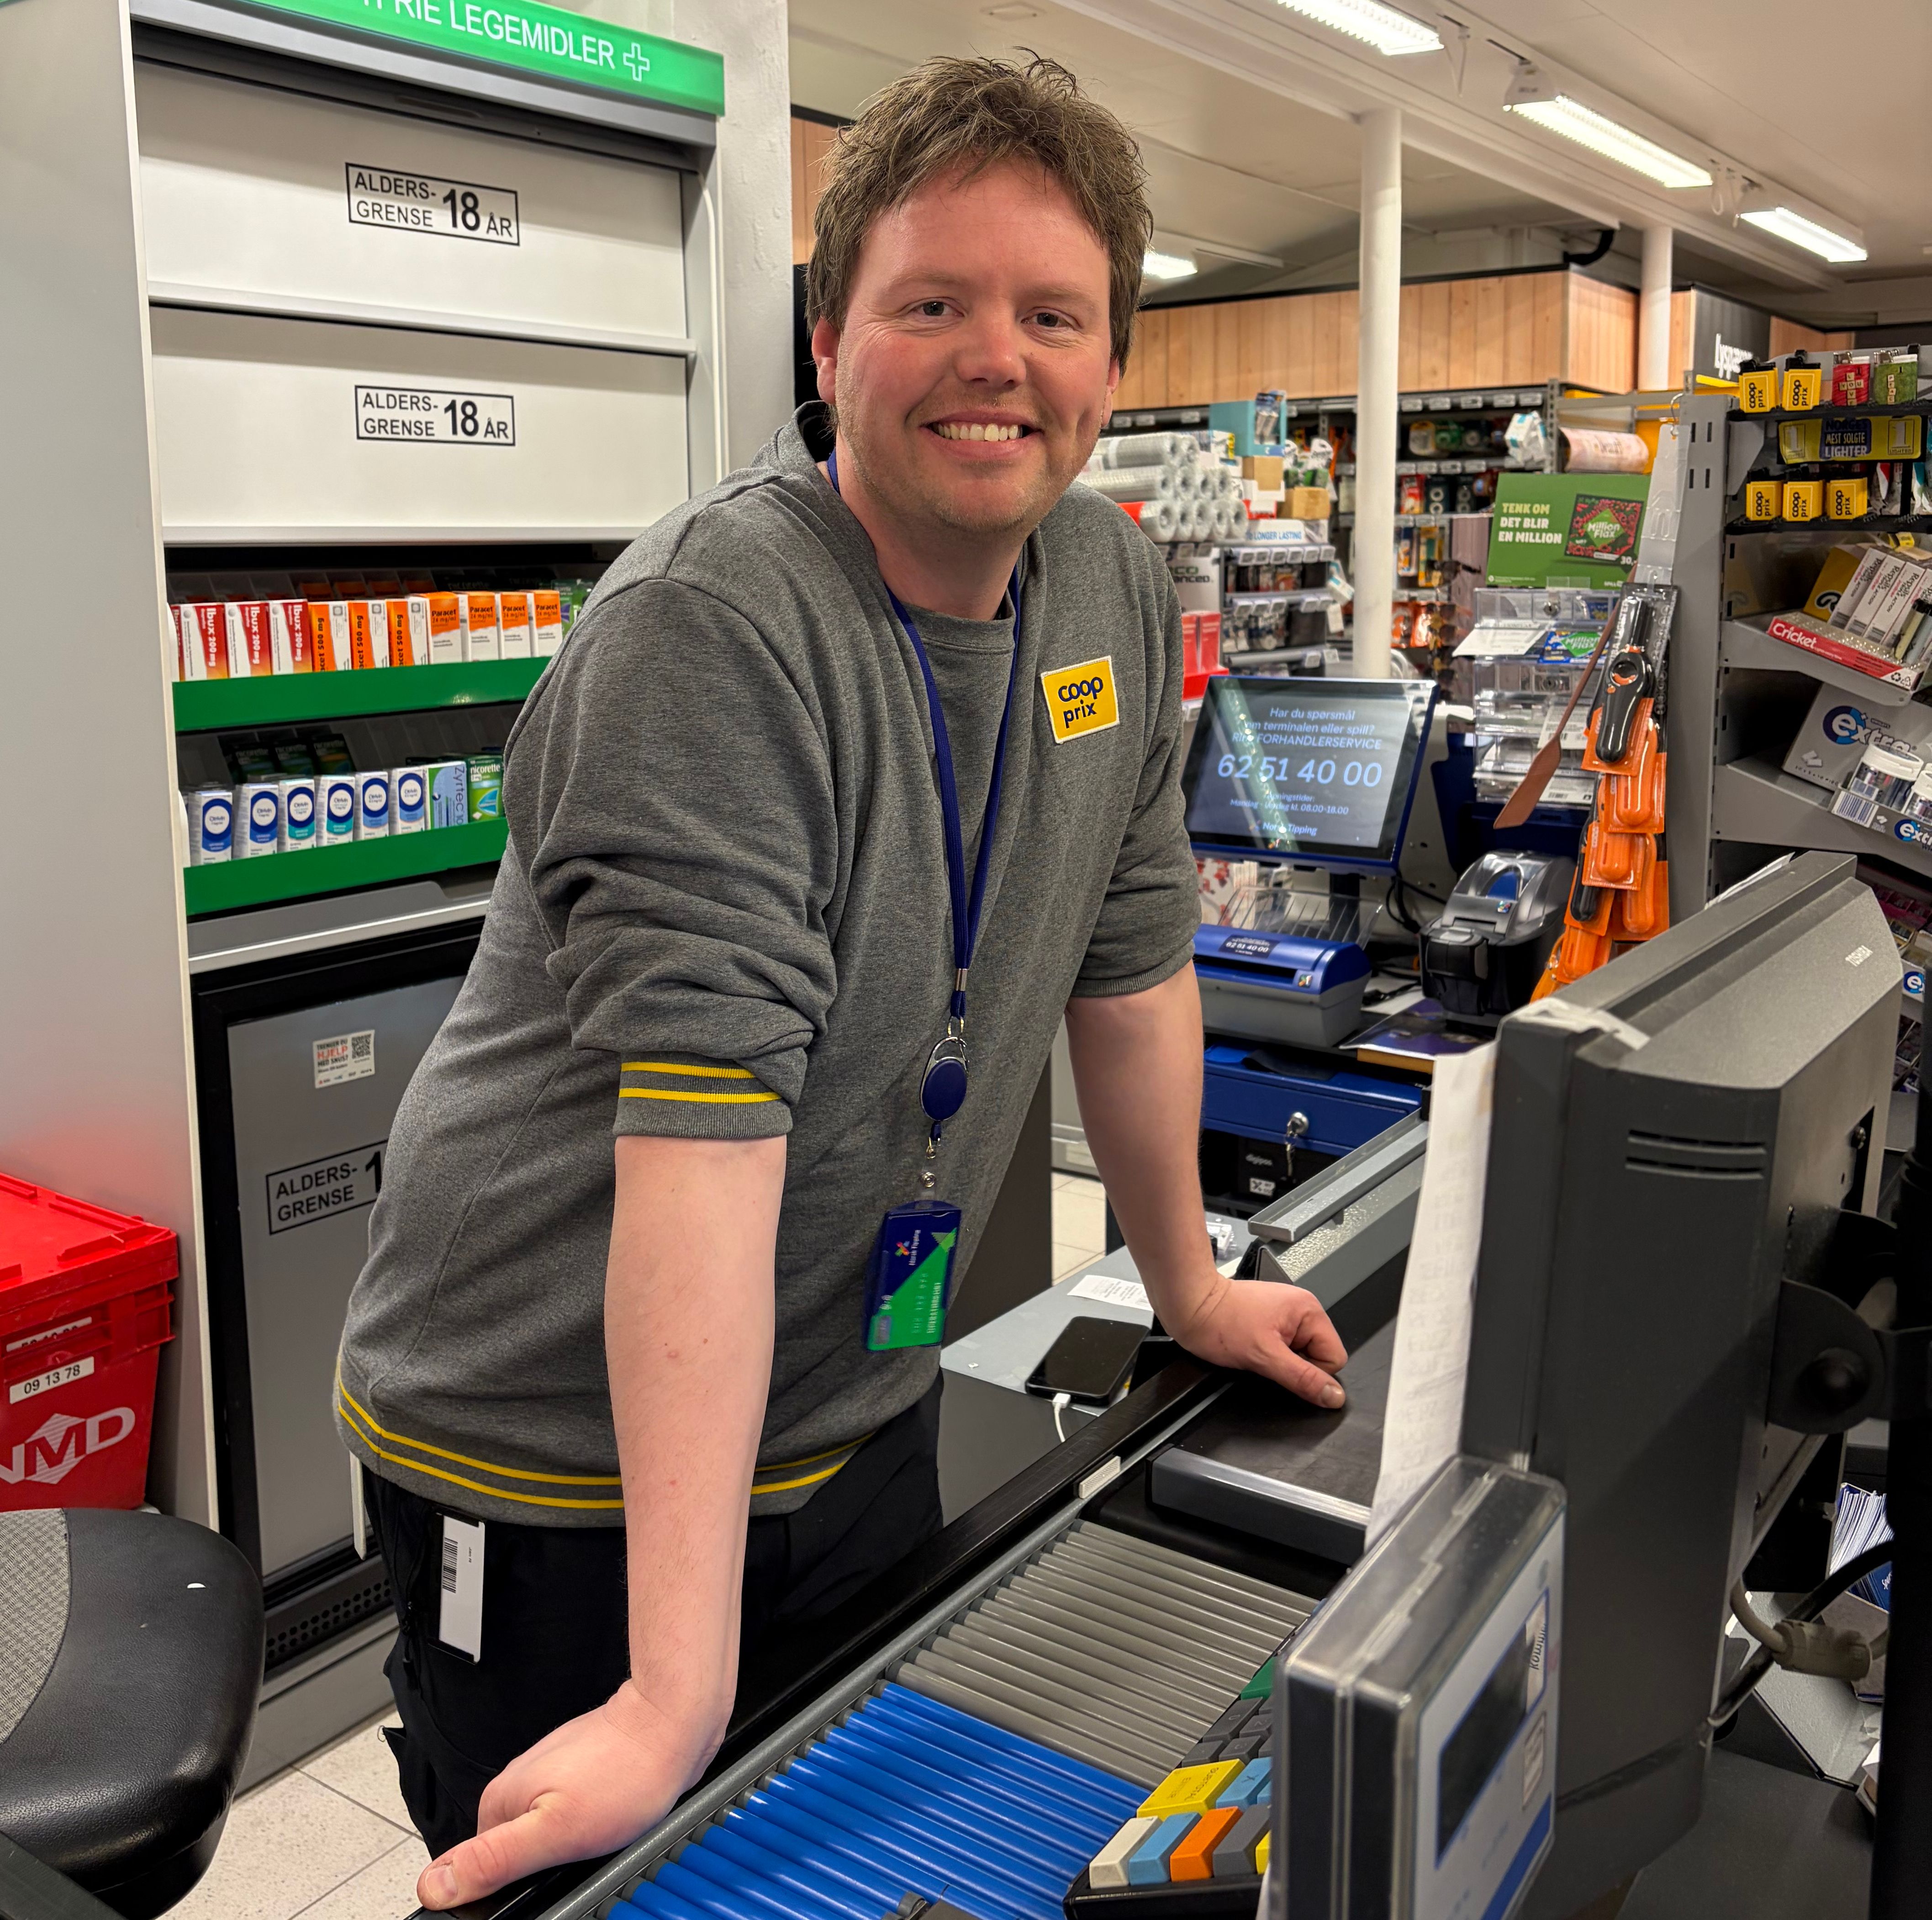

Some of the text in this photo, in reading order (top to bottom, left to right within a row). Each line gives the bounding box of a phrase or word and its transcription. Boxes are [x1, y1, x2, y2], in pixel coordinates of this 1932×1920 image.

[450, 0, 615, 69] LEGEMIDLER
[354, 172, 437, 200] ALDERS-
[356, 201, 434, 227] GRENSE
[442, 188, 514, 238] 18 ÅR
[363, 392, 438, 412] ALDERS-
[1749, 382, 1757, 408] coop
[1756, 390, 1765, 408] prix
[1792, 380, 1802, 406] coop
[1800, 387, 1808, 406] prix
[364, 418, 435, 436] GRENSE
[444, 399, 509, 439] 18 ÅR
[1827, 419, 1868, 430] NORGES
[1826, 433, 1865, 444] MEST SOLGTE
[1825, 445, 1868, 457] LIGHTER
[1502, 503, 1550, 514] TENK OM
[1756, 491, 1764, 517] coop
[1763, 498, 1771, 516] prix
[1792, 492, 1800, 518] coop
[1800, 499, 1808, 517] prix
[1836, 490, 1844, 516] coop
[1842, 497, 1852, 515] prix
[1500, 517, 1549, 529] DET BLIR
[1588, 522, 1620, 531] Million
[1254, 531, 1302, 540] LONGER LASTING
[1499, 531, 1513, 542] EN
[1515, 532, 1562, 544] MILLION
[318, 618, 324, 632] mg
[357, 615, 364, 629] mg
[396, 614, 403, 628] mg
[208, 636, 216, 653] 200
[252, 635, 260, 651] 200
[1773, 623, 1817, 649] Cricket
[1058, 677, 1103, 702] coop
[1063, 699, 1097, 729] prix
[1270, 708, 1355, 721] Har du spørsmål
[1263, 722, 1318, 733] terminalen
[1320, 724, 1345, 734] eller
[1347, 724, 1375, 736] spill?
[1257, 734, 1383, 750] FORHANDLERSERVICE
[470, 763, 500, 774] nicorette
[1218, 754, 1382, 787] 62 51 40 00
[453, 767, 465, 812] Zyrtec
[1263, 822, 1318, 837] Nor Tipping
[317, 1045, 348, 1061] HJELP
[276, 1162, 358, 1199] ALDERS-
[277, 1185, 355, 1222] GRENSE
[24, 1365, 81, 1395] 09 13 78
